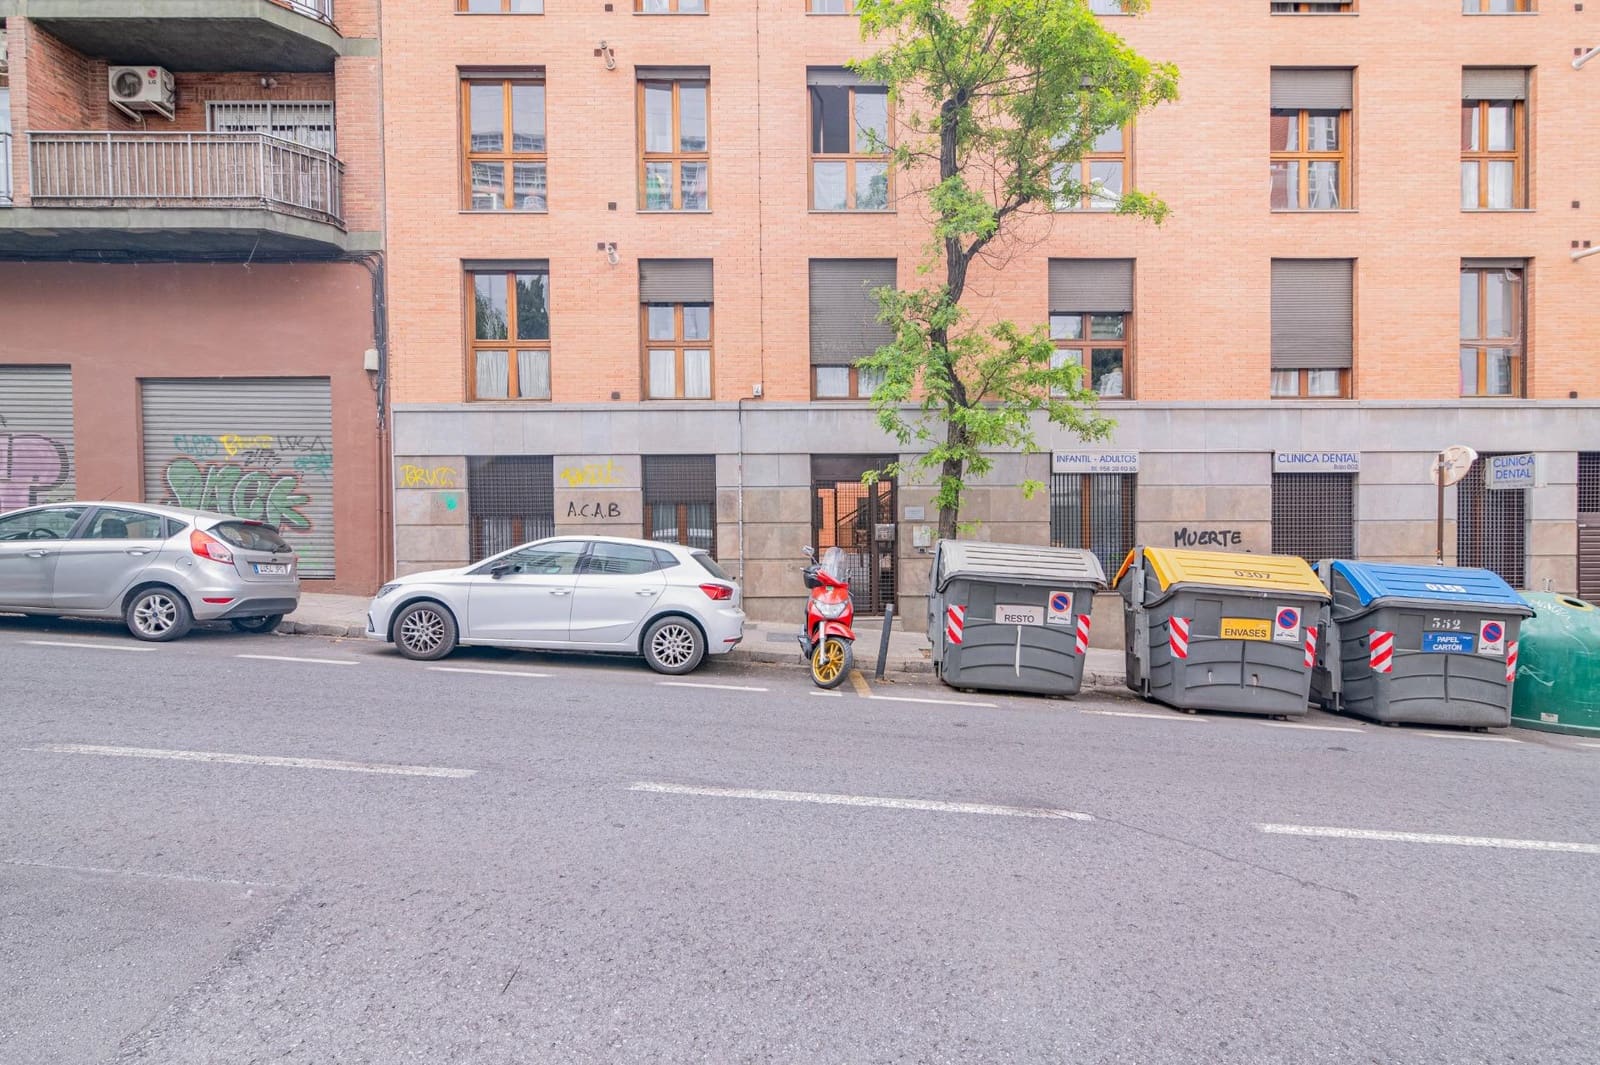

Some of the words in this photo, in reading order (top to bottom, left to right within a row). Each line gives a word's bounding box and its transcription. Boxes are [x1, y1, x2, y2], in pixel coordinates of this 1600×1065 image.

[1056, 455, 1092, 463] INFANTIL
[1099, 455, 1137, 463] ADULTOS
[1278, 453, 1319, 463] CLINICA
[1321, 453, 1358, 463] DENTAL
[1493, 456, 1535, 468] CLINICA
[1495, 469, 1532, 480] DENTAL
[1174, 527, 1242, 547] MUERTE
[1004, 614, 1035, 624] RESTO
[1224, 628, 1267, 638] ENVASES
[1432, 643, 1463, 651] CARTÓN
